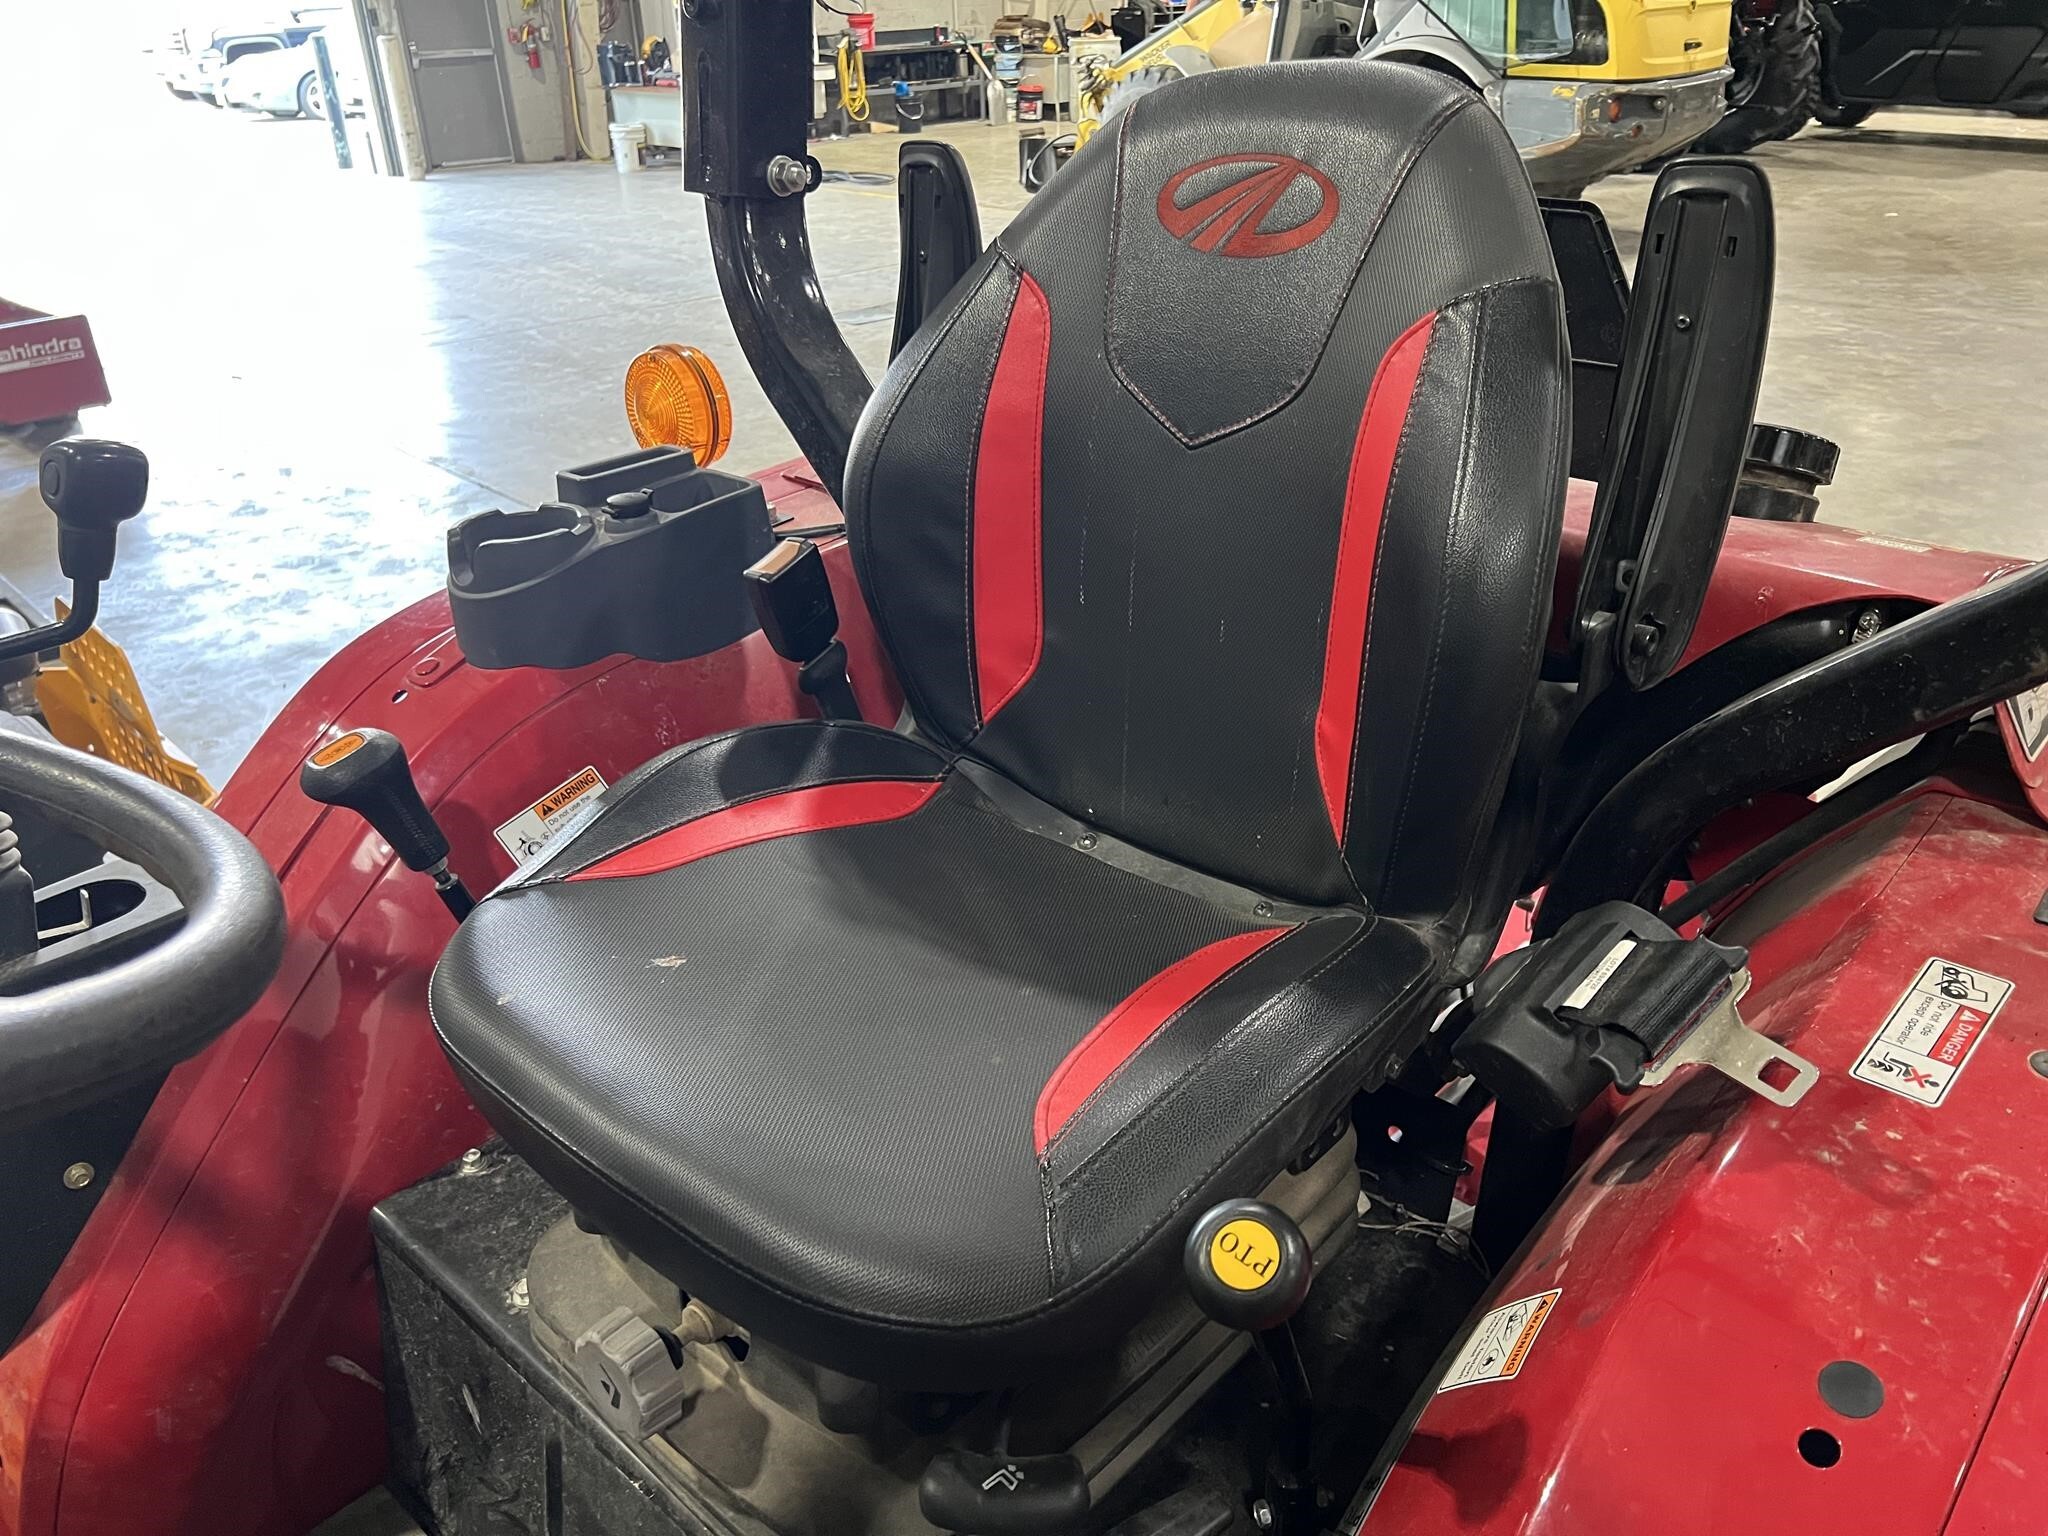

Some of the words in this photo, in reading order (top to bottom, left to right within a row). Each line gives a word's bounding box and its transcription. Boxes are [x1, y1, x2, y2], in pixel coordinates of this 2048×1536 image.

[0, 337, 82, 363] ahindra
[550, 773, 596, 807] WARNING
[548, 817, 559, 826] Do
[559, 809, 570, 819] not
[569, 802, 581, 812] use
[1914, 996, 1935, 1018] except
[1928, 1010, 1942, 1023] not
[1937, 1001, 1952, 1011] Do
[1896, 1017, 1919, 1045] operator
[1919, 1023, 1935, 1037] ride
[1937, 1022, 1975, 1063] DANGER
[1219, 1232, 1276, 1278] PTO
[1506, 1313, 1543, 1372] WARNING
